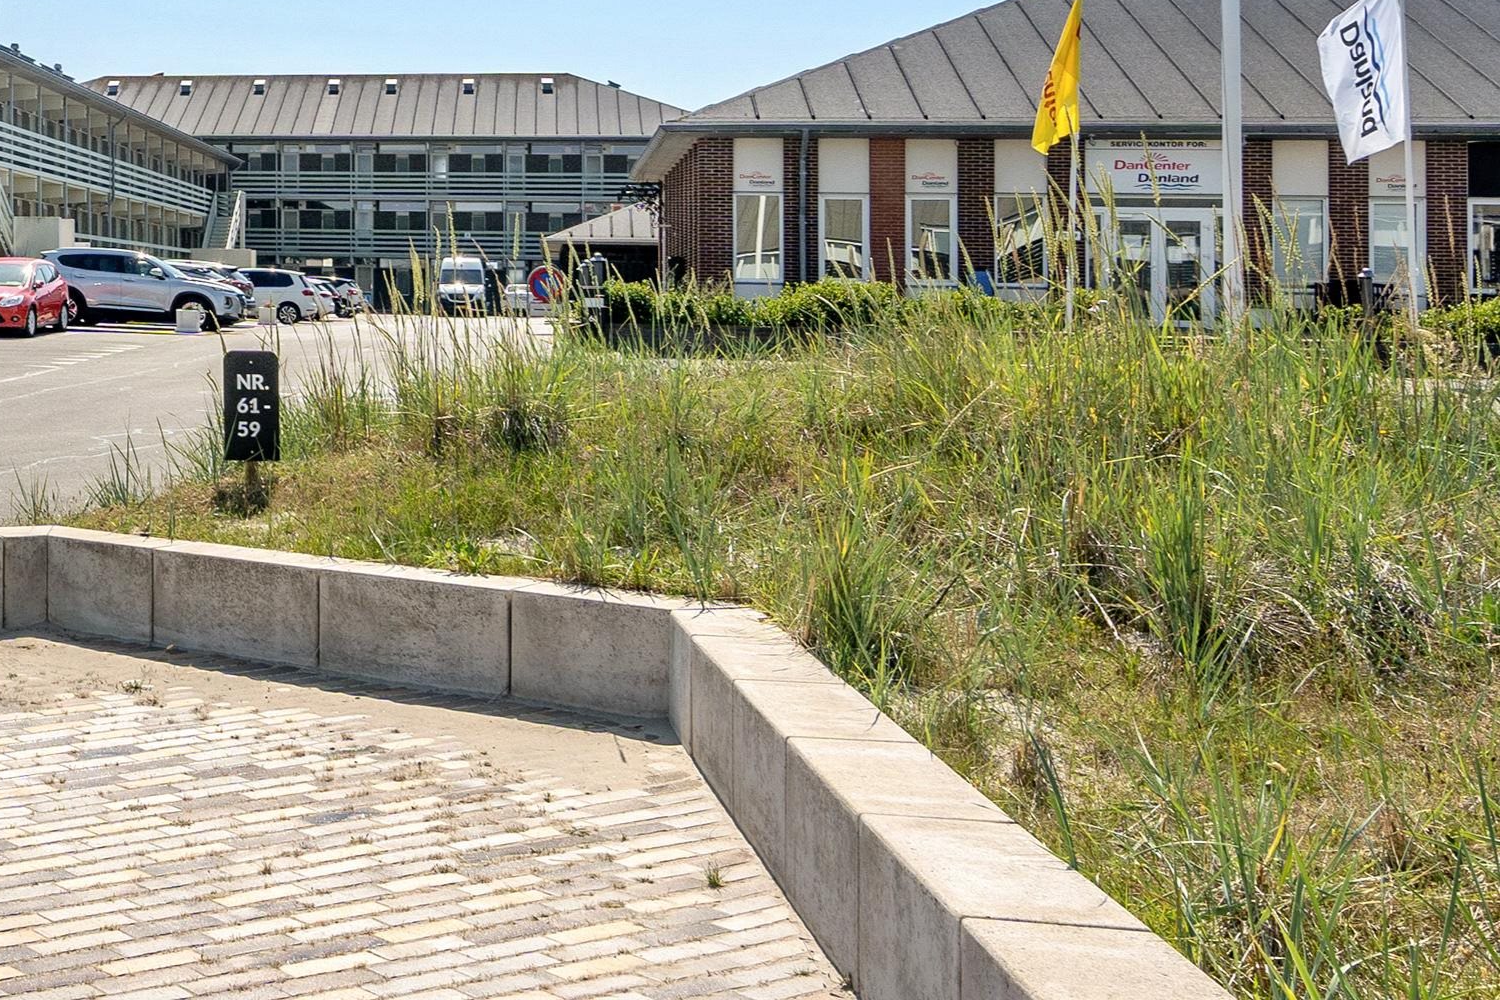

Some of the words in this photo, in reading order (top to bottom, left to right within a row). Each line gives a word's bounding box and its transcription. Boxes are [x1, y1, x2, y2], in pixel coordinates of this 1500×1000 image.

[1137, 173, 1199, 183] Dnland
[236, 373, 270, 390] NR.
[237, 421, 261, 438] 59
